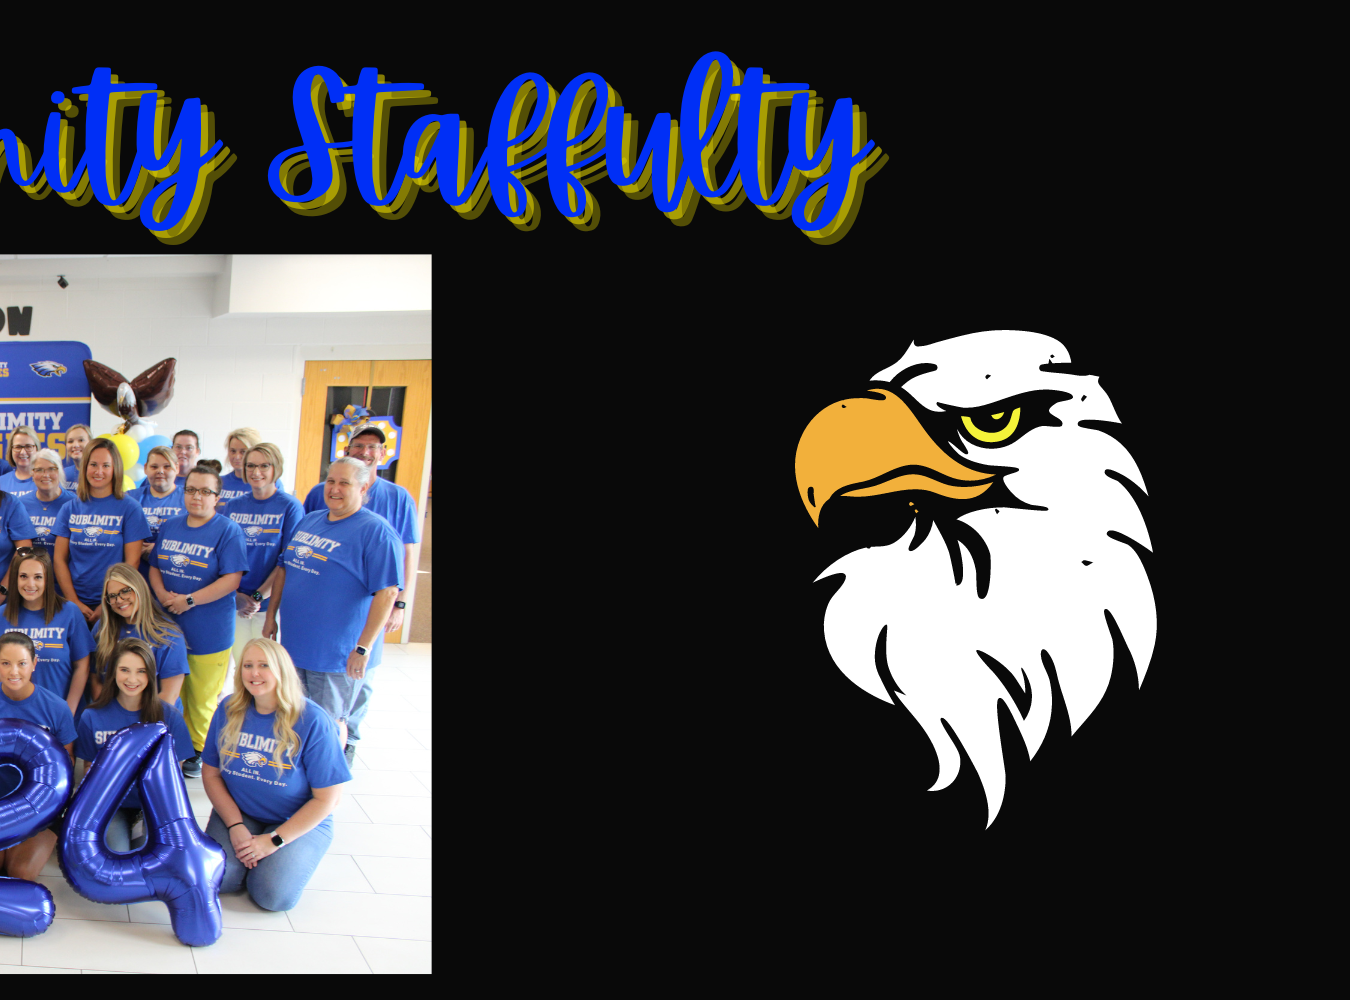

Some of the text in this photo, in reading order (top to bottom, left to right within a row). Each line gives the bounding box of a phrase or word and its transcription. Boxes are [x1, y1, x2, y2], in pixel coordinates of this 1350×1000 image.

[68, 513, 124, 526] SUBLIMITY
[229, 512, 284, 525] SUBLIMITY
[161, 538, 215, 559] SUBLIMITY
[231, 770, 256, 780] Student.
[256, 776, 273, 786] Every
